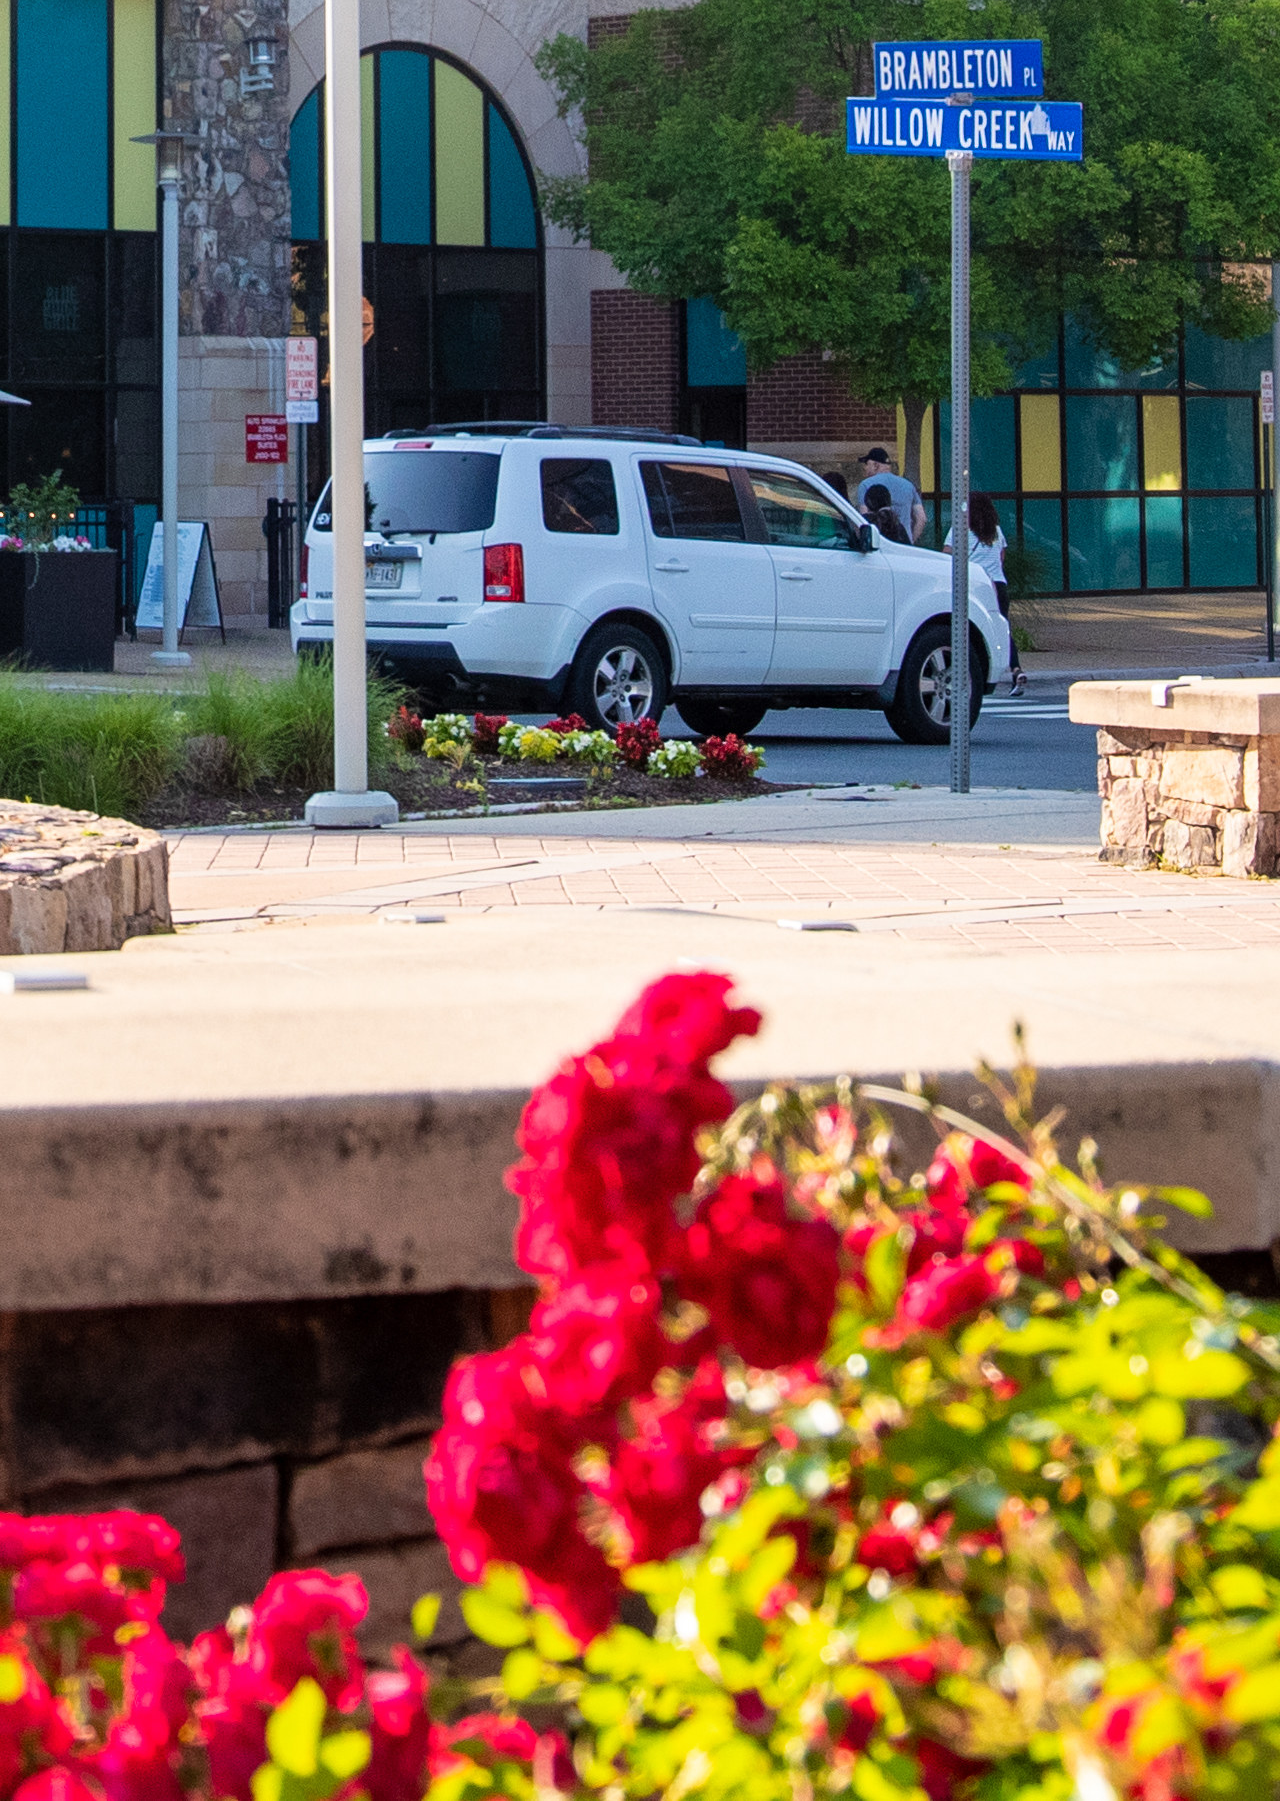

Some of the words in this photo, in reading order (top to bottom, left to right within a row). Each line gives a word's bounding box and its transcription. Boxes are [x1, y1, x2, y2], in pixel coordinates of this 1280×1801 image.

[879, 49, 1013, 91] BRAMBLETON
[1024, 66, 1037, 88] PL
[853, 106, 944, 147] WILLOW
[958, 109, 1034, 150] CREEK
[1047, 130, 1075, 151] WAY
